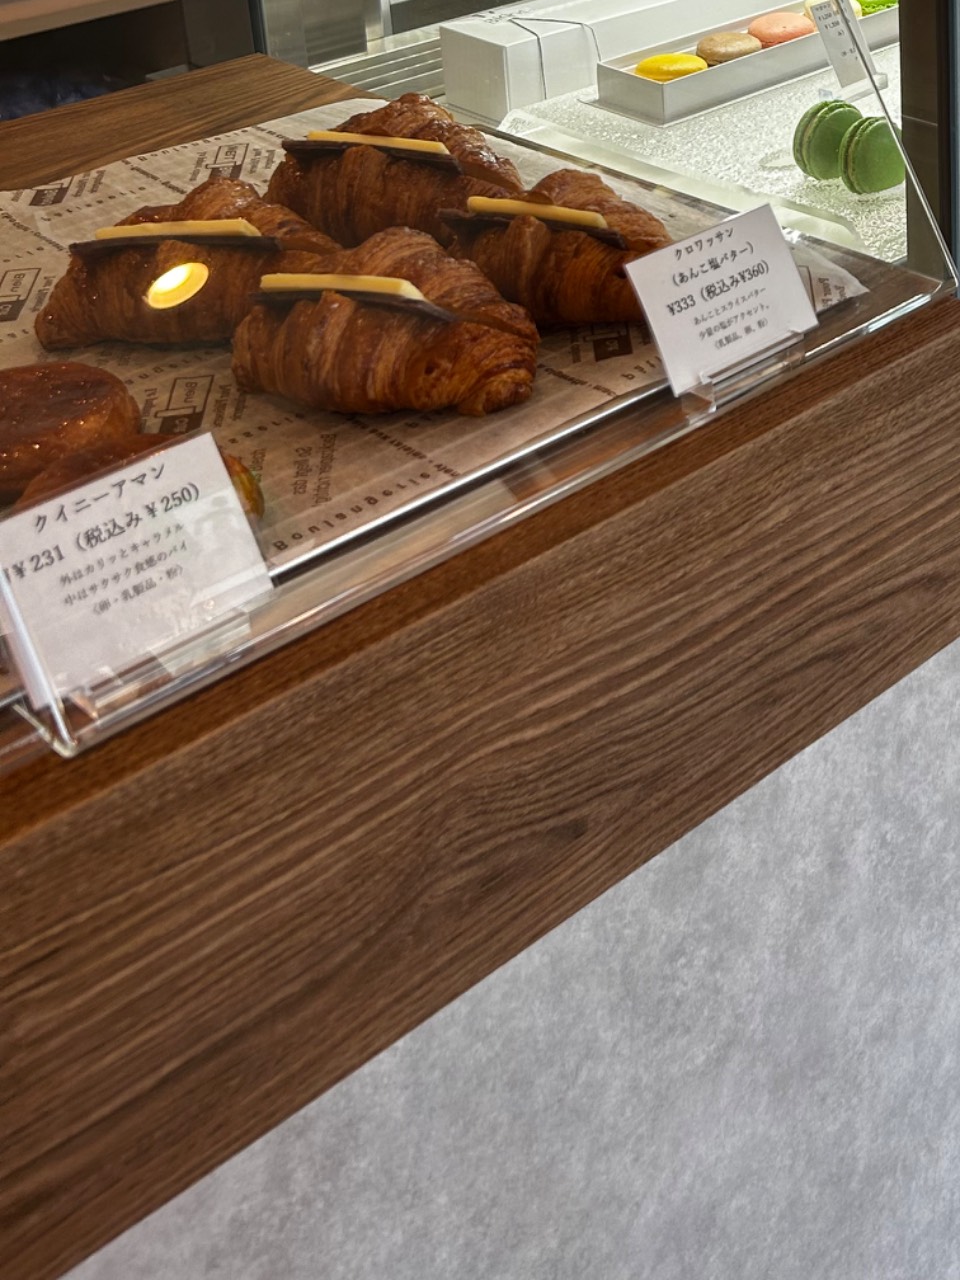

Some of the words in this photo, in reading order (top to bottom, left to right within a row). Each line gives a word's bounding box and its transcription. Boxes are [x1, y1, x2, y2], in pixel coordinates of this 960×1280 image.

[672, 241, 754, 287] (あんこ塩バター)
[675, 227, 734, 261] クロワッサン
[35, 463, 165, 533] クイニーアマン
[12, 544, 66, 579] ¥231
[60, 523, 184, 587] 外はカリッとキャラメル
